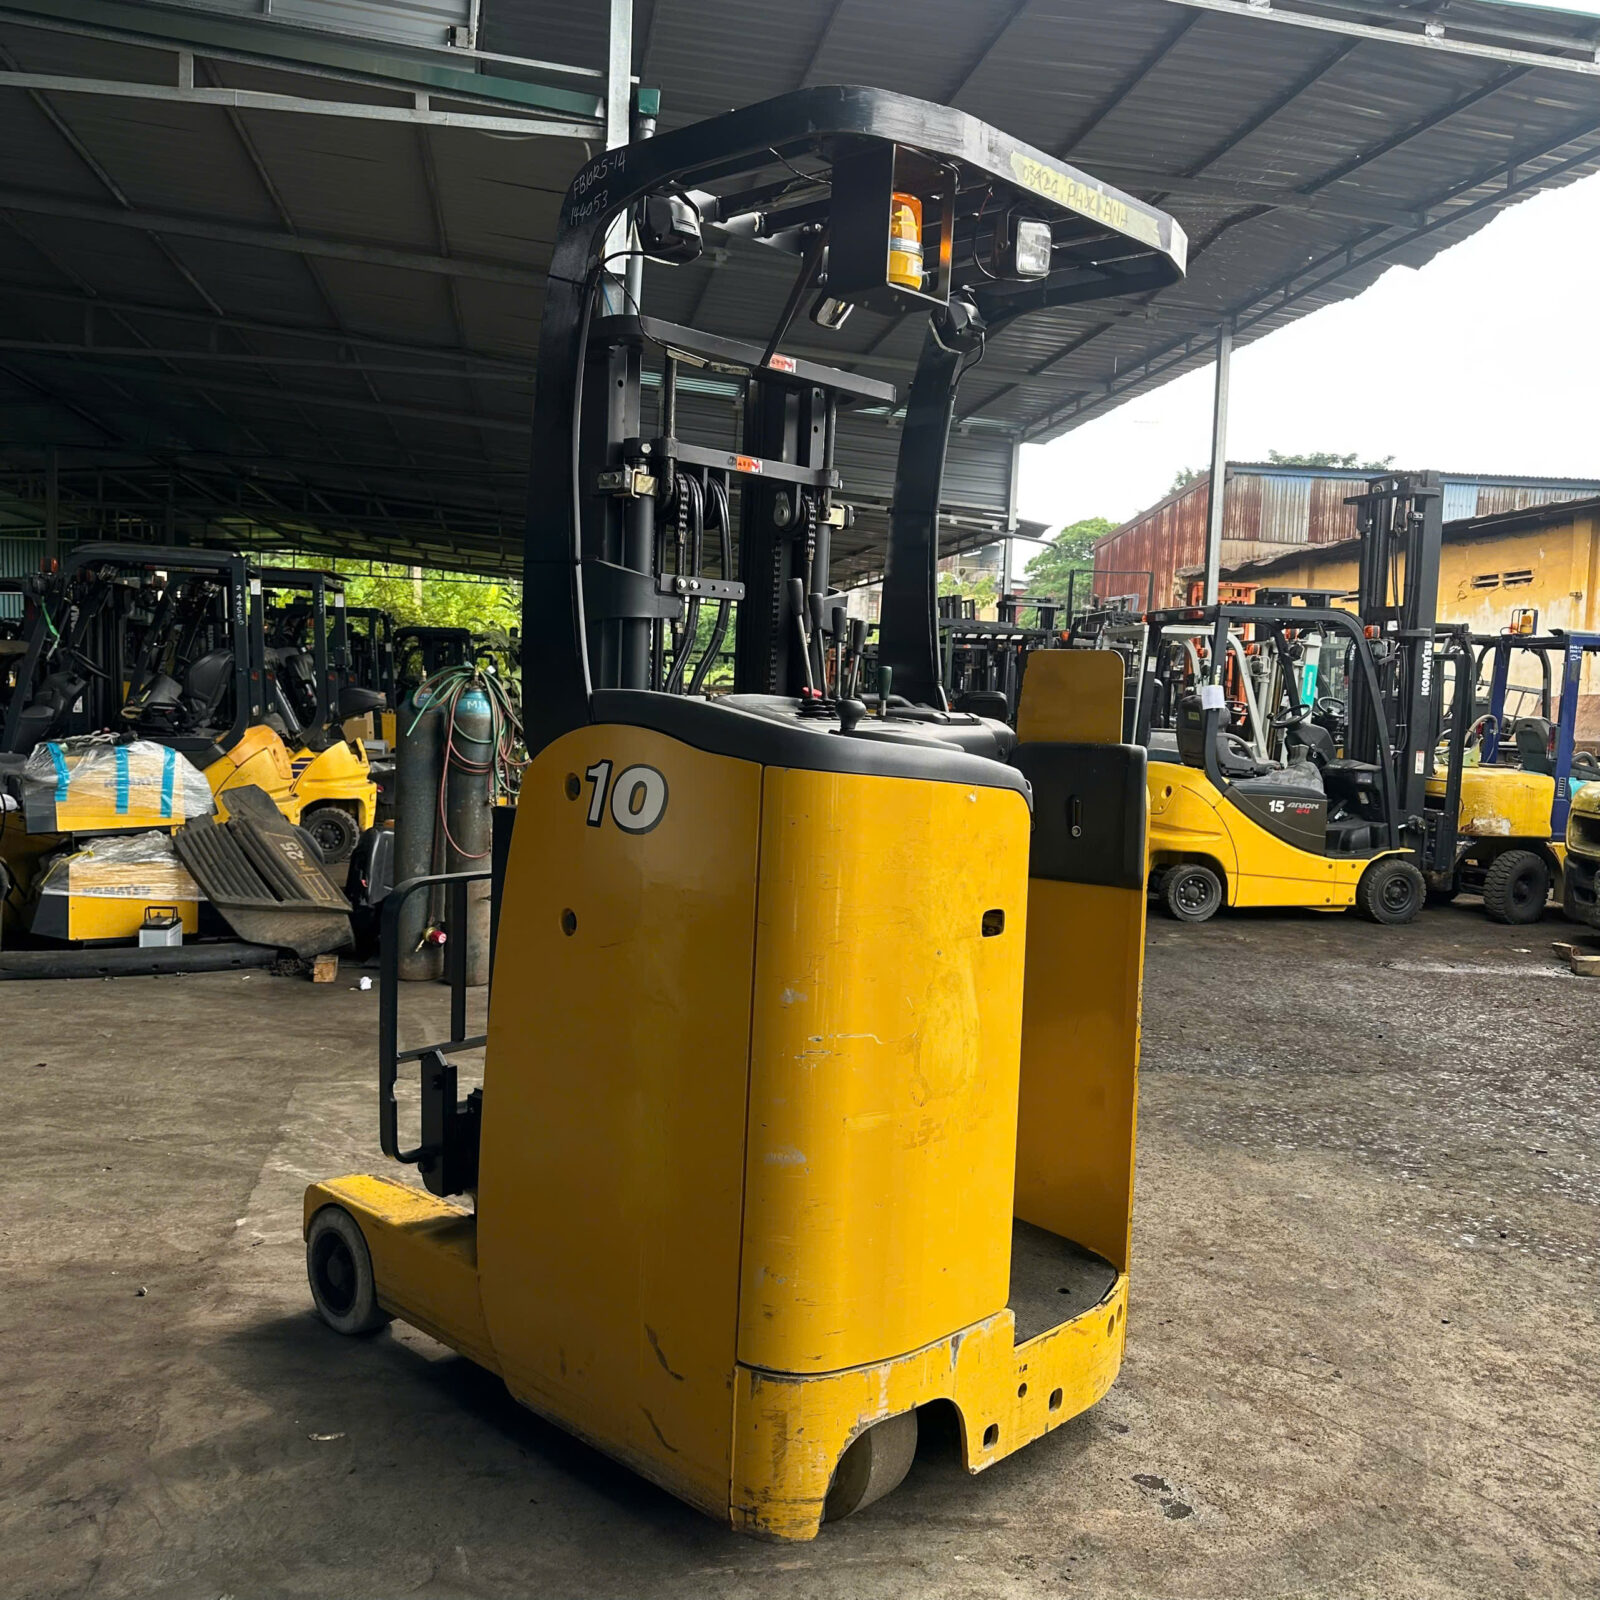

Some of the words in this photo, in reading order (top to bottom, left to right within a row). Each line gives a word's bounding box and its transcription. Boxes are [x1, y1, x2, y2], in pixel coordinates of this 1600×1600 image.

[570, 189, 609, 226] 144053
[1420, 640, 1433, 696] KOMATSU
[585, 758, 669, 835] 10
[1268, 800, 1285, 813] 15
